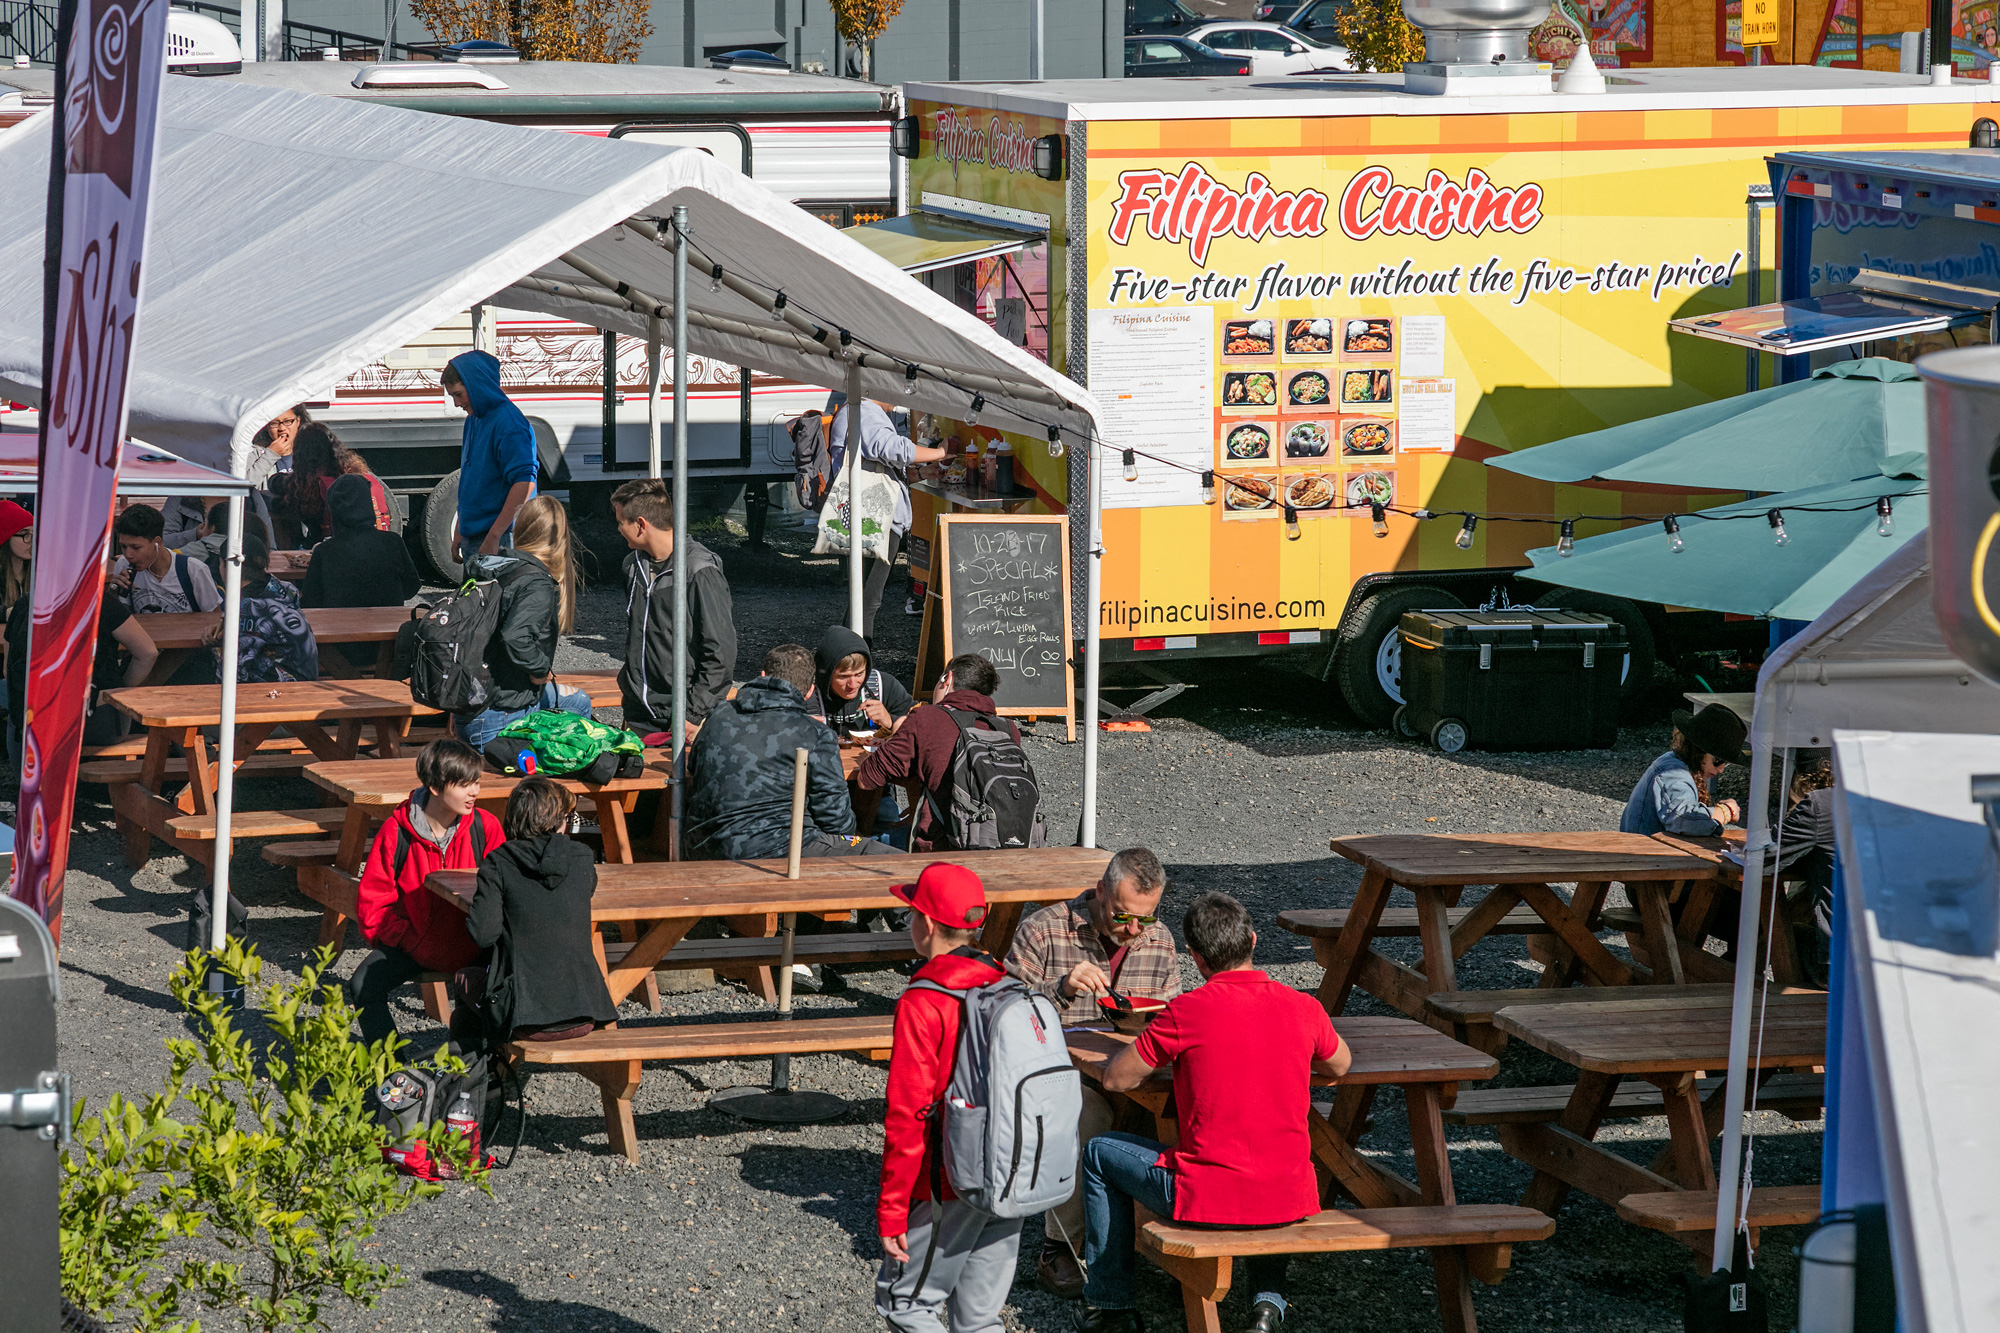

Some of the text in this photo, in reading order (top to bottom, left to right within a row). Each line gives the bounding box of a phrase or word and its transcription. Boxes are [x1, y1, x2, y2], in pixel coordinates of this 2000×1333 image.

[1755, 2, 1766, 14] NO
[1745, 21, 1777, 36] TRAIN HORN
[1591, 40, 1615, 55] BELL
[1824, 42, 1854, 50] CREEK
[1593, 57, 1620, 66] ATION
[935, 105, 985, 182] Filipina
[1108, 161, 1544, 269] Filipina Cuisine
[1109, 251, 1742, 312] Five-star flavor without the five-star price!
[1112, 312, 1192, 329] Filipina Cuisine
[1023, 586, 1050, 603] FRIED
[994, 604, 1028, 617] RICE
[1100, 597, 1325, 631] filipinacuisine.com
[991, 620, 1005, 636] 2
